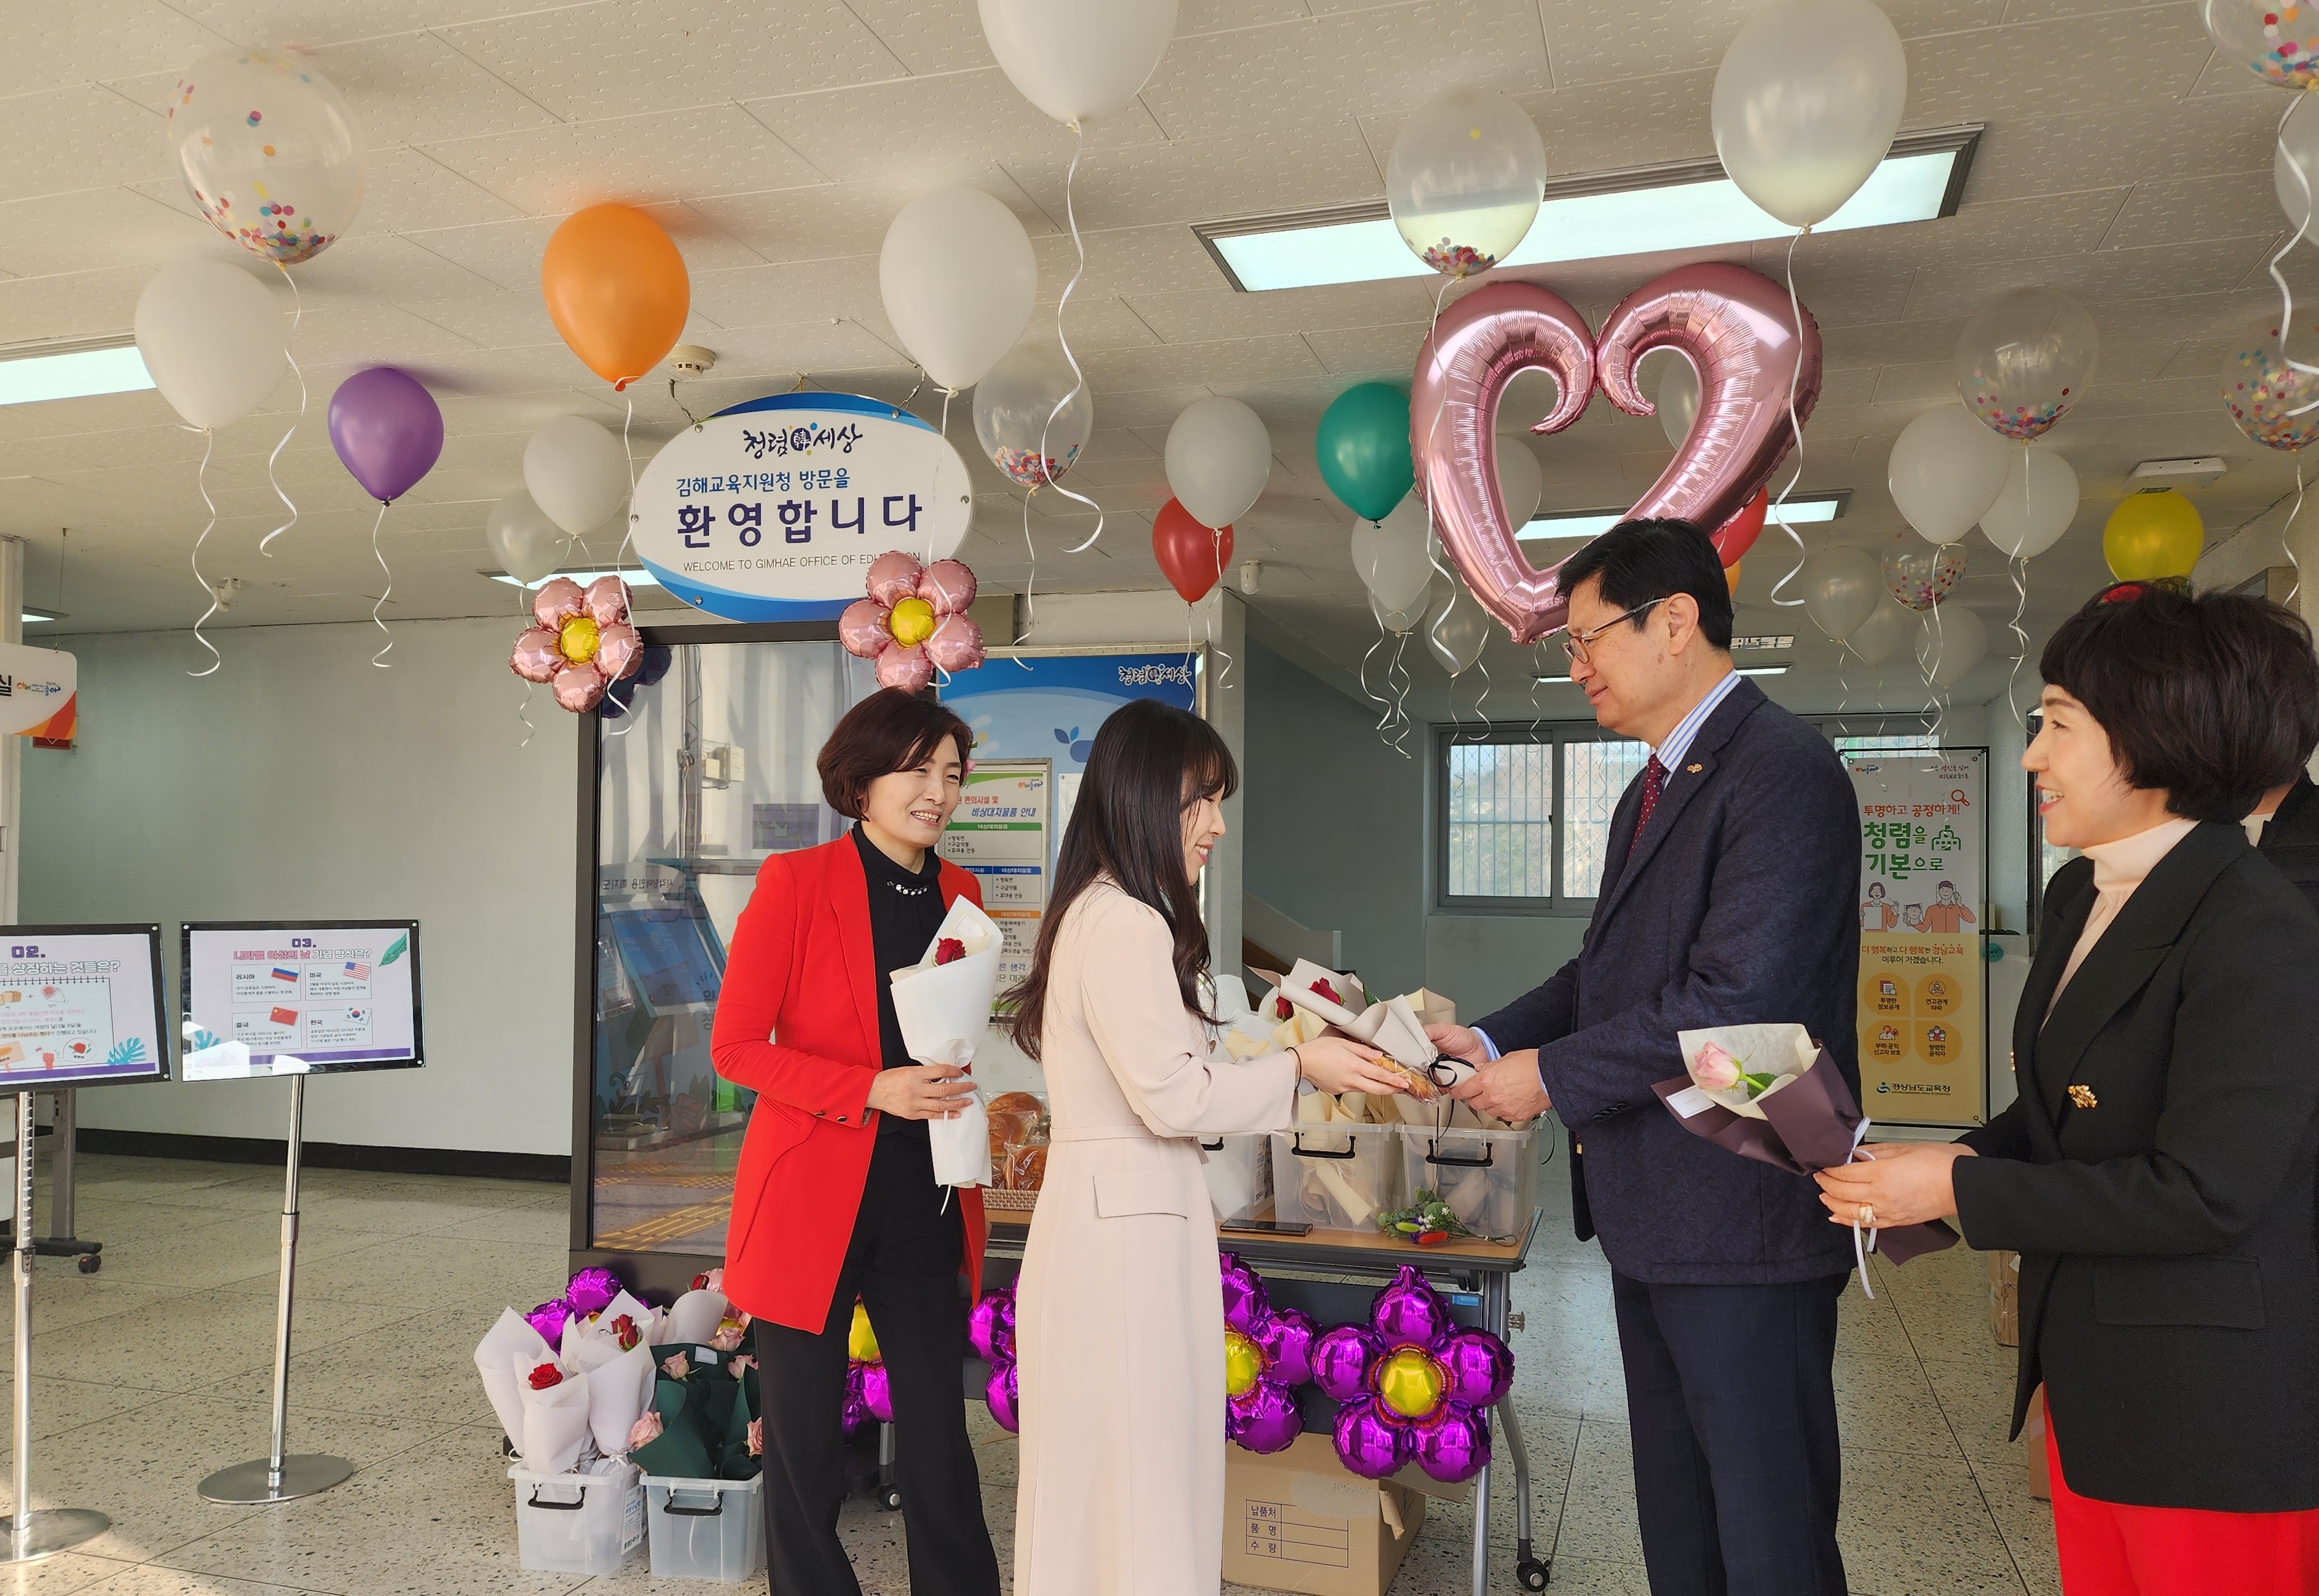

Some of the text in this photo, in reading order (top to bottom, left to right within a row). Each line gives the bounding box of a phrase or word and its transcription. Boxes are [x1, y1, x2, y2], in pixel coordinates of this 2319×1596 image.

[676, 468, 851, 497] 김해교육지원청 방문을
[677, 494, 922, 548] 환영합니다
[683, 560, 735, 572] WELCOME
[738, 559, 752, 570] TO
[755, 557, 796, 568] GIMHAE
[800, 555, 838, 567] OFFICE
[841, 554, 856, 565] OF
[964, 796, 990, 804] 편의시설
[992, 796, 998, 804] 및
[1020, 808, 1036, 817] 안내
[1864, 804, 1960, 817] 투명하고 공정하게!
[1864, 822, 1927, 849] 청렴을
[1865, 854, 1944, 879] 기본으로
[292, 938, 317, 948] 03.
[11, 946, 45, 958] 02.
[267, 950, 297, 960] 여성의
[300, 949, 310, 960] 날
[312, 949, 333, 959] 기념
[334, 948, 372, 959] 방식은?
[1871, 946, 1898, 954] 행복하고
[1932, 946, 1964, 955] 경남교육
[1905, 956, 1943, 964] 가겠습니다.
[12, 962, 67, 975] 상징하는
[70, 961, 120, 973] 것들은?
[1010, 963, 1025, 972] 생각
[1892, 1083, 1951, 1092] 경상남도교육청
[1251, 1505, 1277, 1519] 납품처
